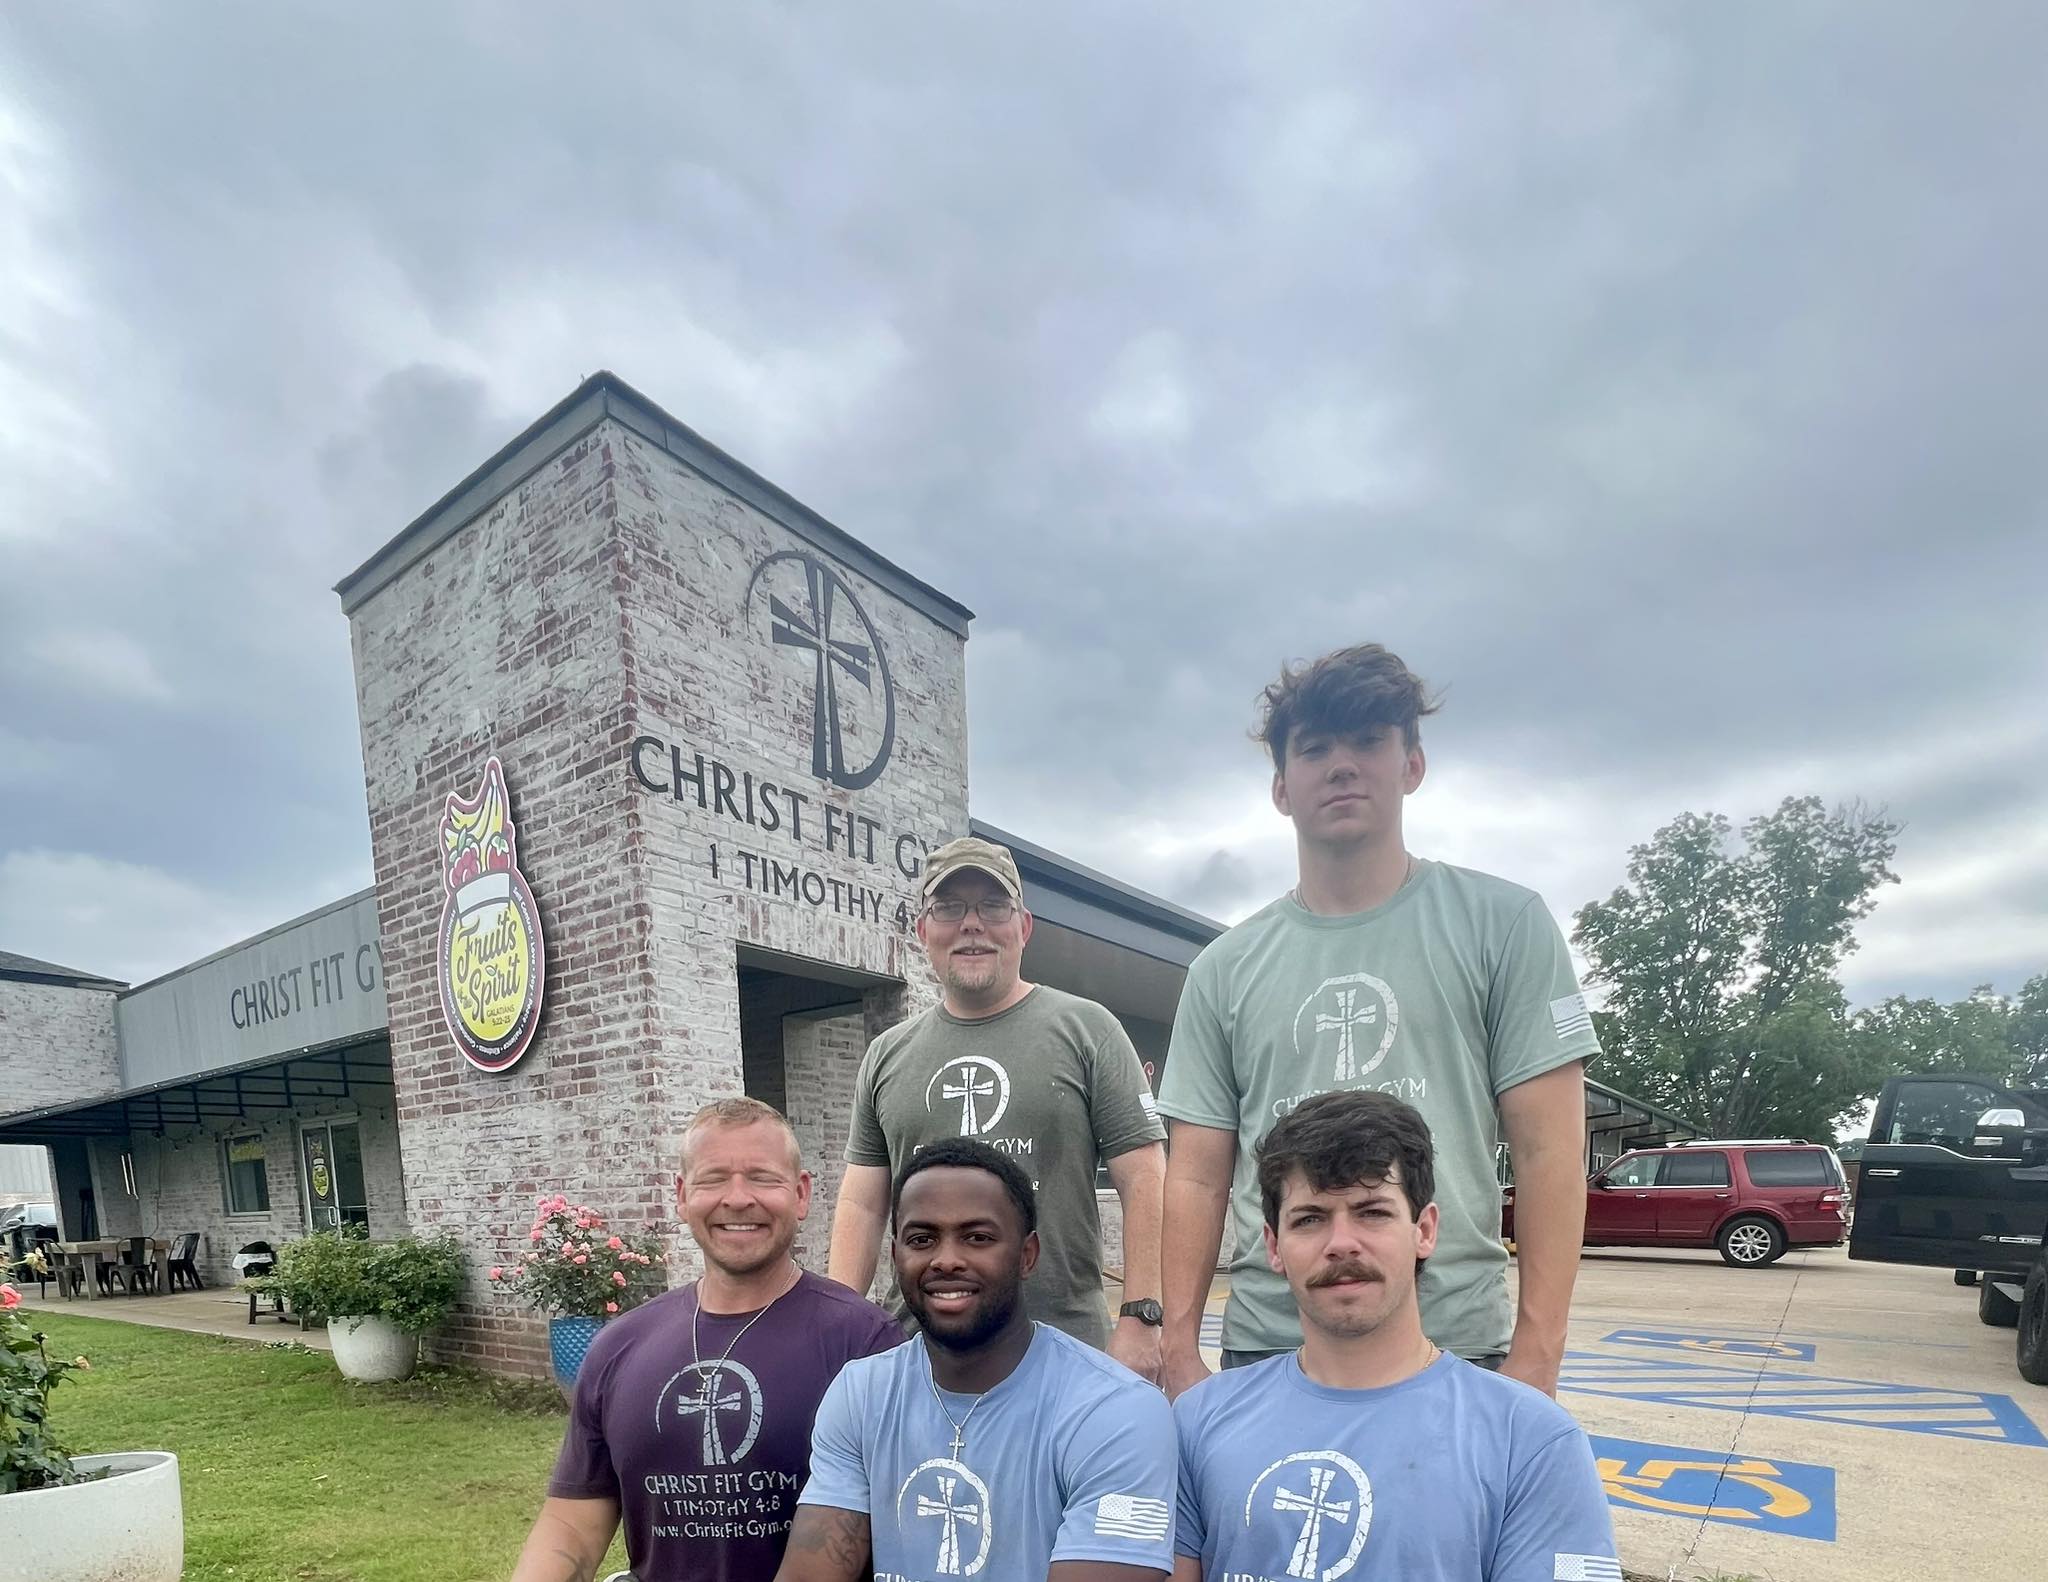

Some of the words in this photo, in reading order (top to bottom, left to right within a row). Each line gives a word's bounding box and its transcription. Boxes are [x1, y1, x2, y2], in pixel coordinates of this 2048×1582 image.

[632, 735, 808, 841] CHRIST
[824, 803, 881, 865] FIT
[738, 850, 884, 923] TIMOTHY
[444, 909, 457, 960] Faithfulness
[457, 911, 518, 984] Fruits
[520, 901, 535, 935] Control
[231, 966, 302, 1029] CHRIST
[310, 951, 345, 1008] FIT
[469, 953, 521, 1025] Spirit
[521, 998, 534, 1024] Peace
[644, 1473, 708, 1494] CHRIST
[715, 1472, 743, 1494] FIT
[748, 1470, 798, 1491] GYM
[674, 1497, 750, 1516] TIMOTHY
[755, 1495, 780, 1513] 4:8
